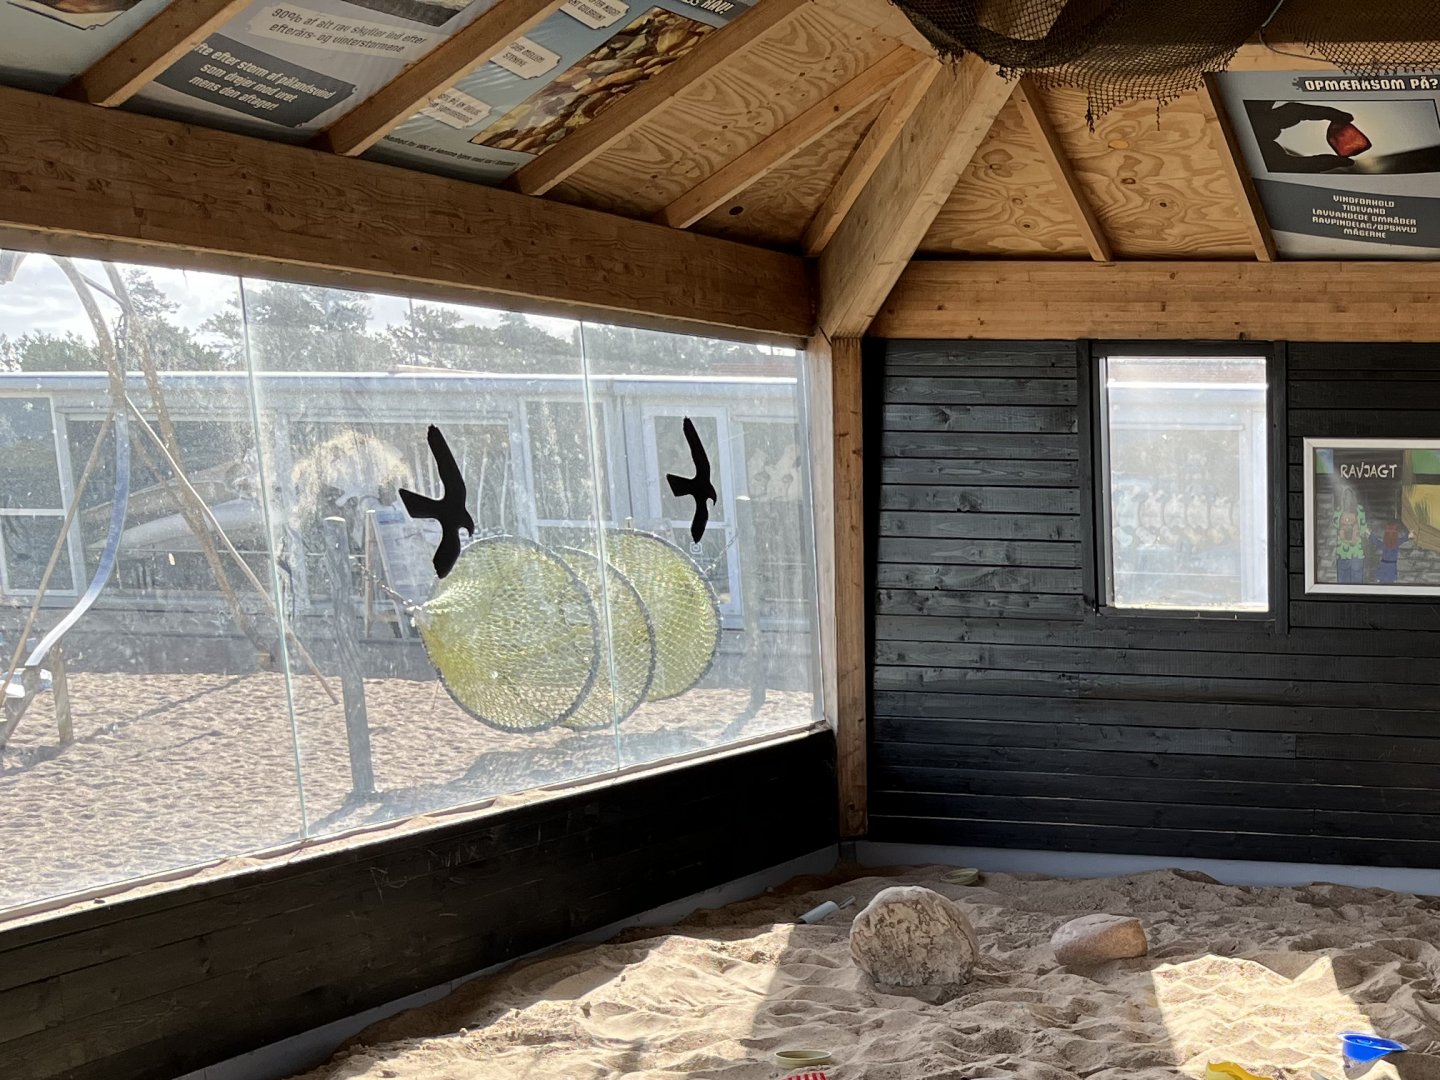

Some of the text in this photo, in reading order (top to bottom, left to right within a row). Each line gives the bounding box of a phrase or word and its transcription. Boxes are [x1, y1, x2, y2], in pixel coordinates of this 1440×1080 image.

[272, 8, 302, 23] 90%
[303, 16, 318, 27] af
[317, 17, 334, 29] alt
[333, 23, 351, 32] rav
[350, 26, 387, 38] skyller
[402, 33, 427, 44] efter
[269, 23, 405, 52] efterårs- og vinterstormene
[212, 51, 240, 66] efter
[237, 61, 269, 77] storm
[266, 72, 283, 84] af
[189, 76, 221, 91] mens
[219, 87, 240, 98] den
[200, 64, 226, 78] som
[224, 72, 256, 87] drejer
[253, 83, 280, 95] mod
[1305, 76, 1439, 91] OPMÆRKSOM PÅ?
[1333, 194, 1395, 208] VINDFORHOLD
[1342, 204, 1386, 215] TIDEVAND
[1312, 208, 1416, 225] LAVVANDEDE OMRÅDER
[1343, 228, 1386, 239] MÅGERNE
[1340, 461, 1398, 479] RAVJAGT
